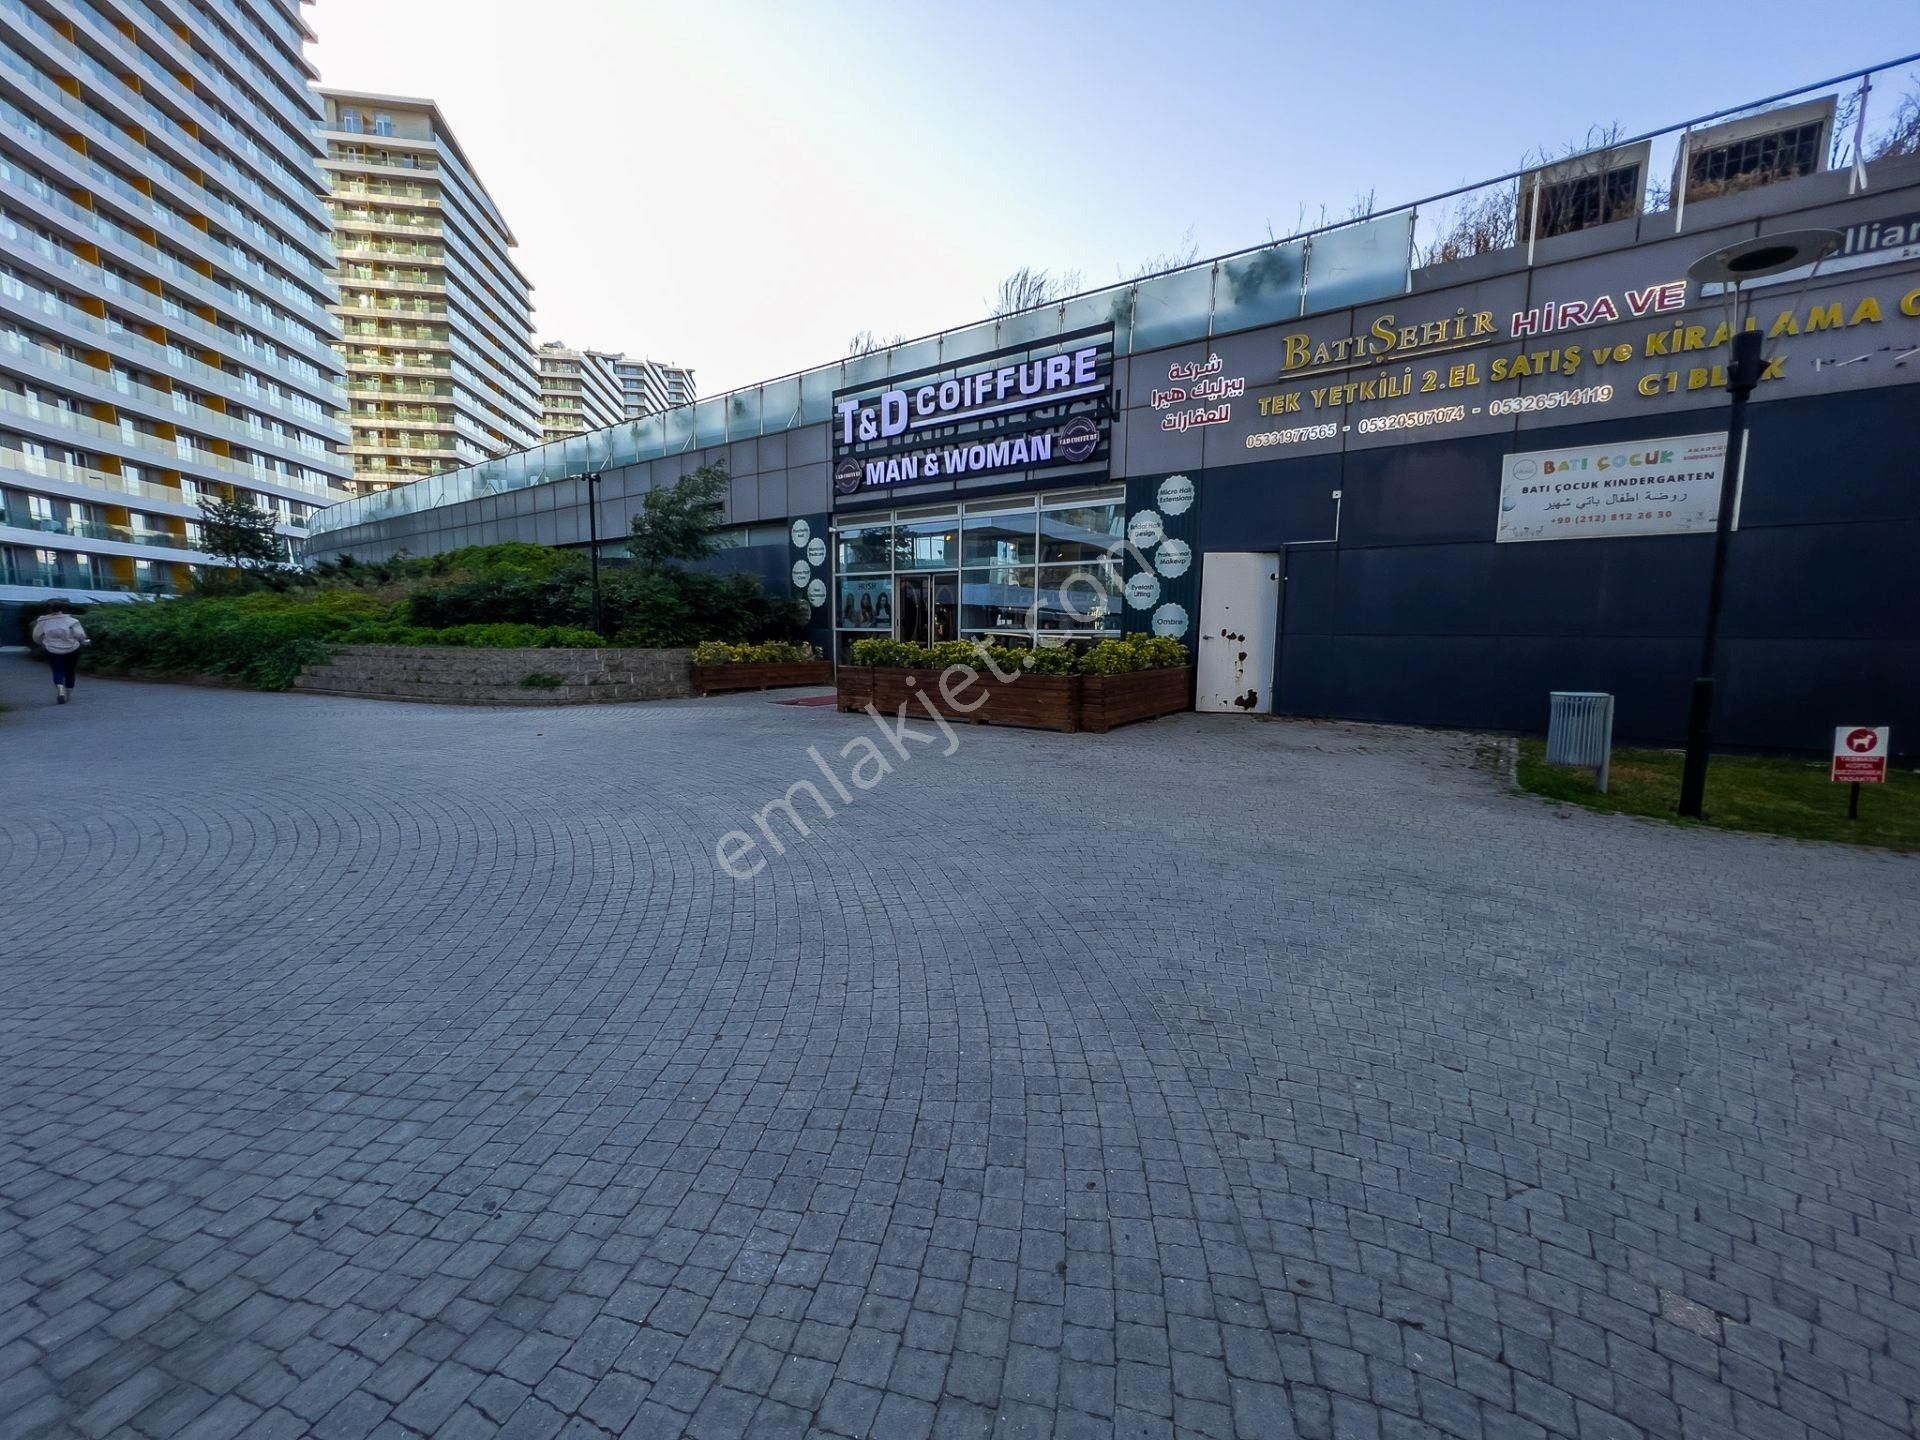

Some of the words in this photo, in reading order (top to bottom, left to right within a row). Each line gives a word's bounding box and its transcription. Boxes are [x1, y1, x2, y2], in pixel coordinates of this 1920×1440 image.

[1826, 222, 1920, 257] llia
[1510, 295, 1619, 337] HİRA
[1624, 280, 1688, 318] VE
[1168, 352, 1223, 382] شركة
[1258, 391, 1301, 417] TEK
[1311, 367, 1413, 409] YETKİLİ
[1490, 345, 1582, 383] SATIŞ
[1592, 343, 1634, 366] ve
[1687, 354, 1789, 391] BLK
[837, 389, 908, 444] T&D
[916, 347, 1097, 416] COIFFURE
[1150, 387, 1186, 410] هيرا
[1190, 376, 1245, 401] بيرليك
[1161, 403, 1231, 433] للعقارات
[1245, 422, 1337, 449] 05331977565
[1357, 404, 1465, 434] 05320507074
[1488, 384, 1614, 417] 05326514119
[865, 455, 918, 486] MAN
[924, 452, 939, 477] &
[945, 434, 1052, 474] WOMAN
[1543, 456, 1589, 475] BATI
[1596, 450, 1675, 471] ÇOCUK
[1521, 485, 1551, 495] BATI
[1554, 480, 1600, 494] ÇOCUK
[1603, 471, 1715, 488] KINDERGARTEN
[1644, 489, 1688, 502] روضة
[1605, 492, 1639, 506] اطفال
[1575, 514, 1606, 524] (212)
[1657, 510, 1672, 518] 30
[1131, 584, 1155, 592] Eyelash
